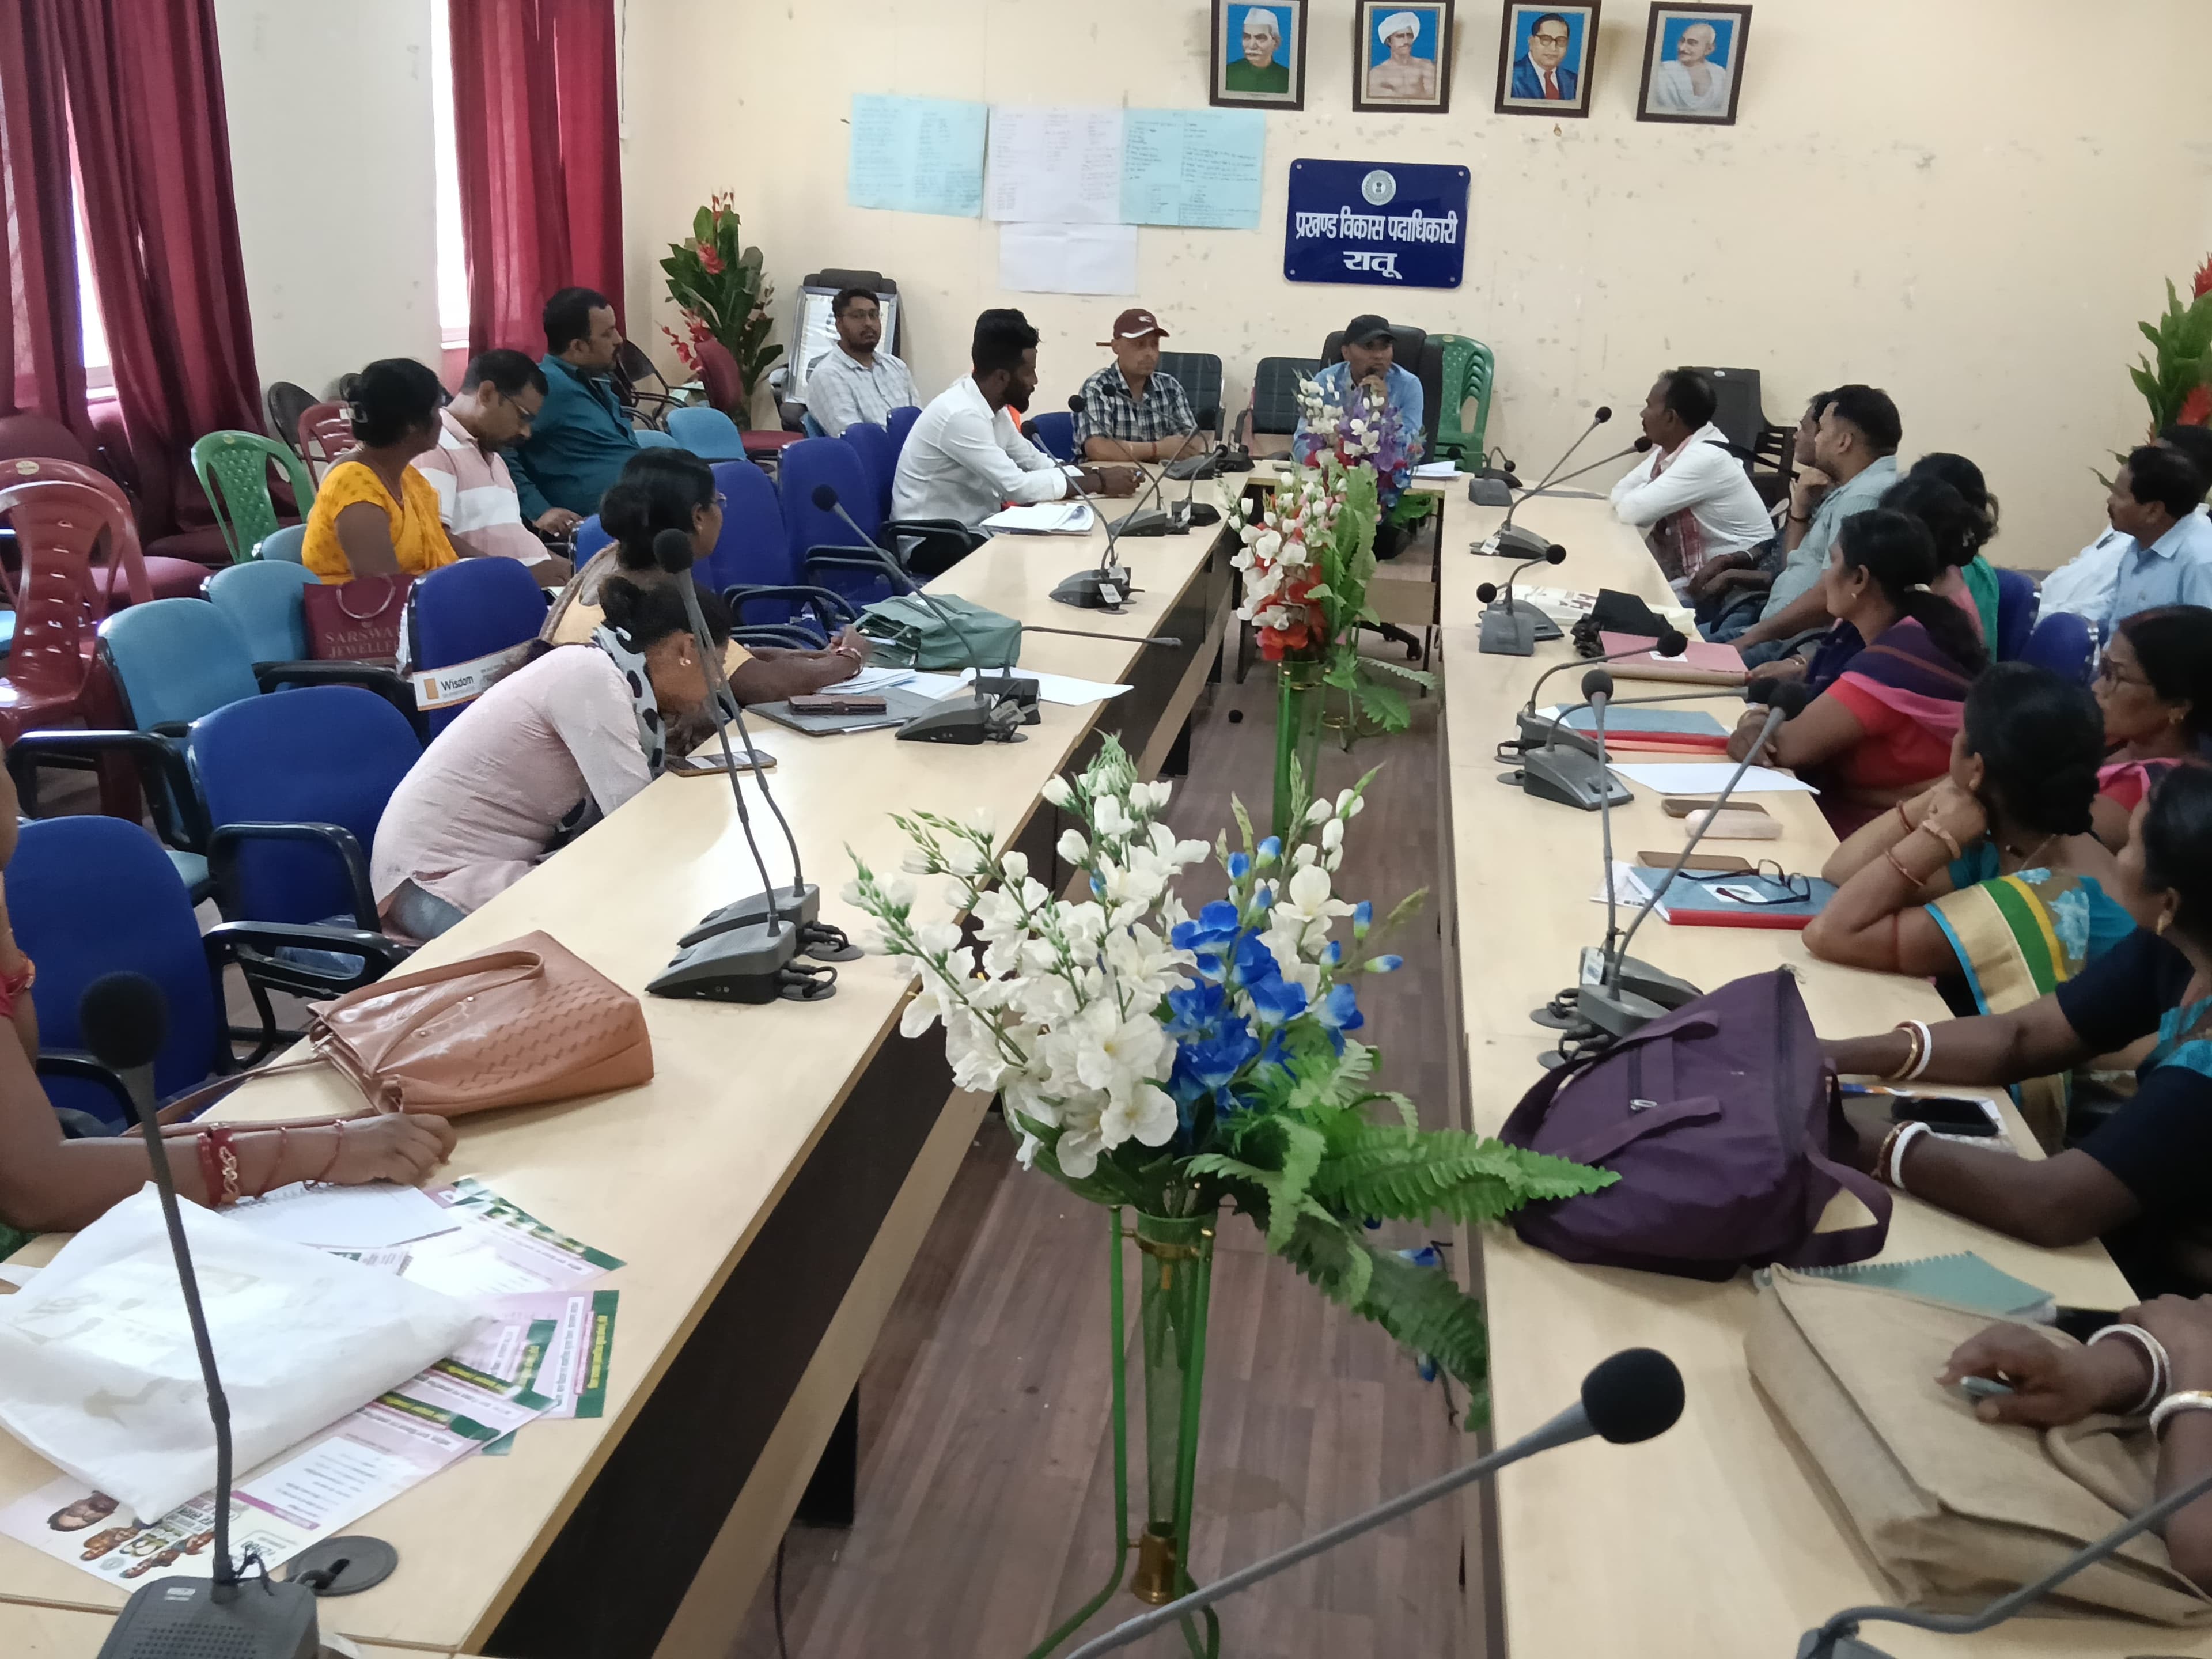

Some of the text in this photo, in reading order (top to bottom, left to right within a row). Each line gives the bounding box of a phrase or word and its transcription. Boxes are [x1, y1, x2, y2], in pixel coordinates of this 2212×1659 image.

[1296, 206, 1458, 244] प्रखण्ड विकास पदाधिकारी
[1343, 251, 1402, 279] रातू
[325, 626, 400, 643] SARSWA
[441, 675, 474, 691] Wisdom
